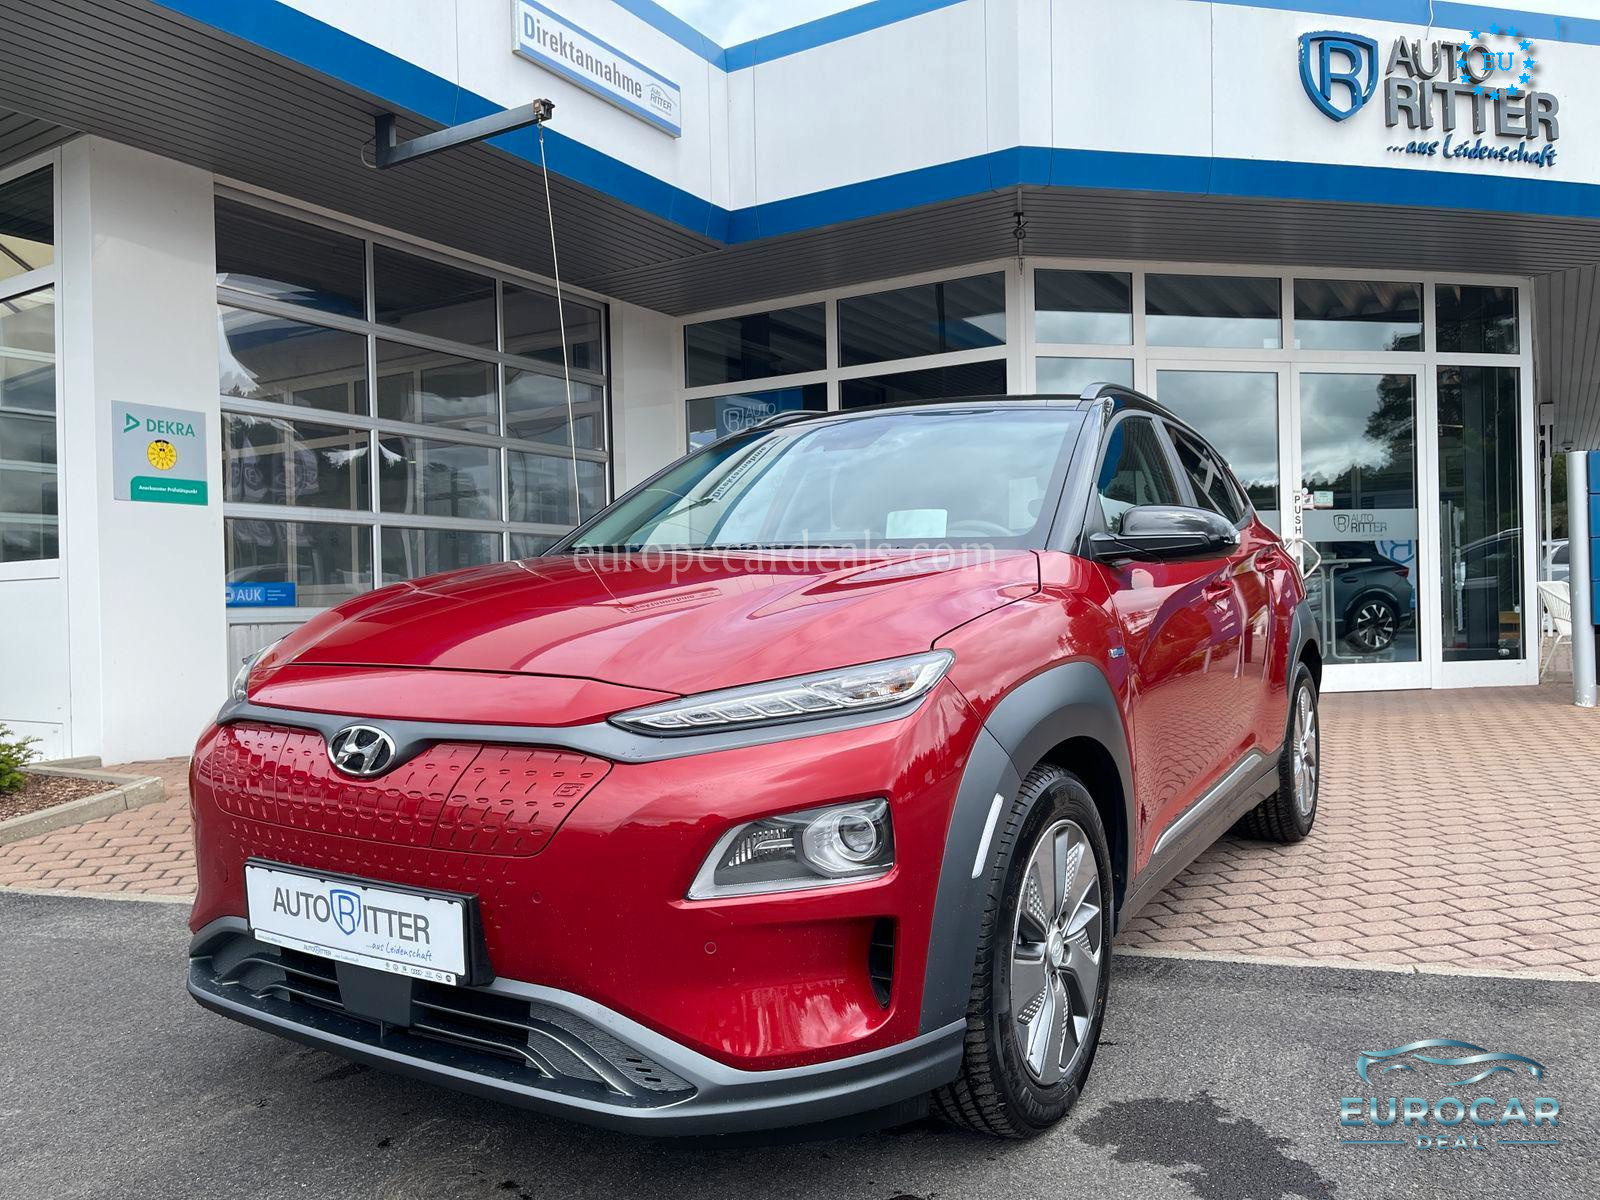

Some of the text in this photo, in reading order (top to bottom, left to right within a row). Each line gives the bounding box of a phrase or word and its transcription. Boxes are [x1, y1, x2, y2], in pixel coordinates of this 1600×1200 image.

[523, 11, 642, 99] Direktannahme
[1385, 36, 1494, 84] AUTO
[1384, 76, 1560, 142] RITTER
[1442, 133, 1557, 168] Leidenschaft
[746, 402, 777, 418] AUTO
[146, 418, 196, 438] DEKRA
[1294, 495, 1302, 535] PUSH
[1350, 521, 1388, 533] RITTER
[236, 589, 262, 601] AUK
[385, 942, 433, 962] Leidenschaft
